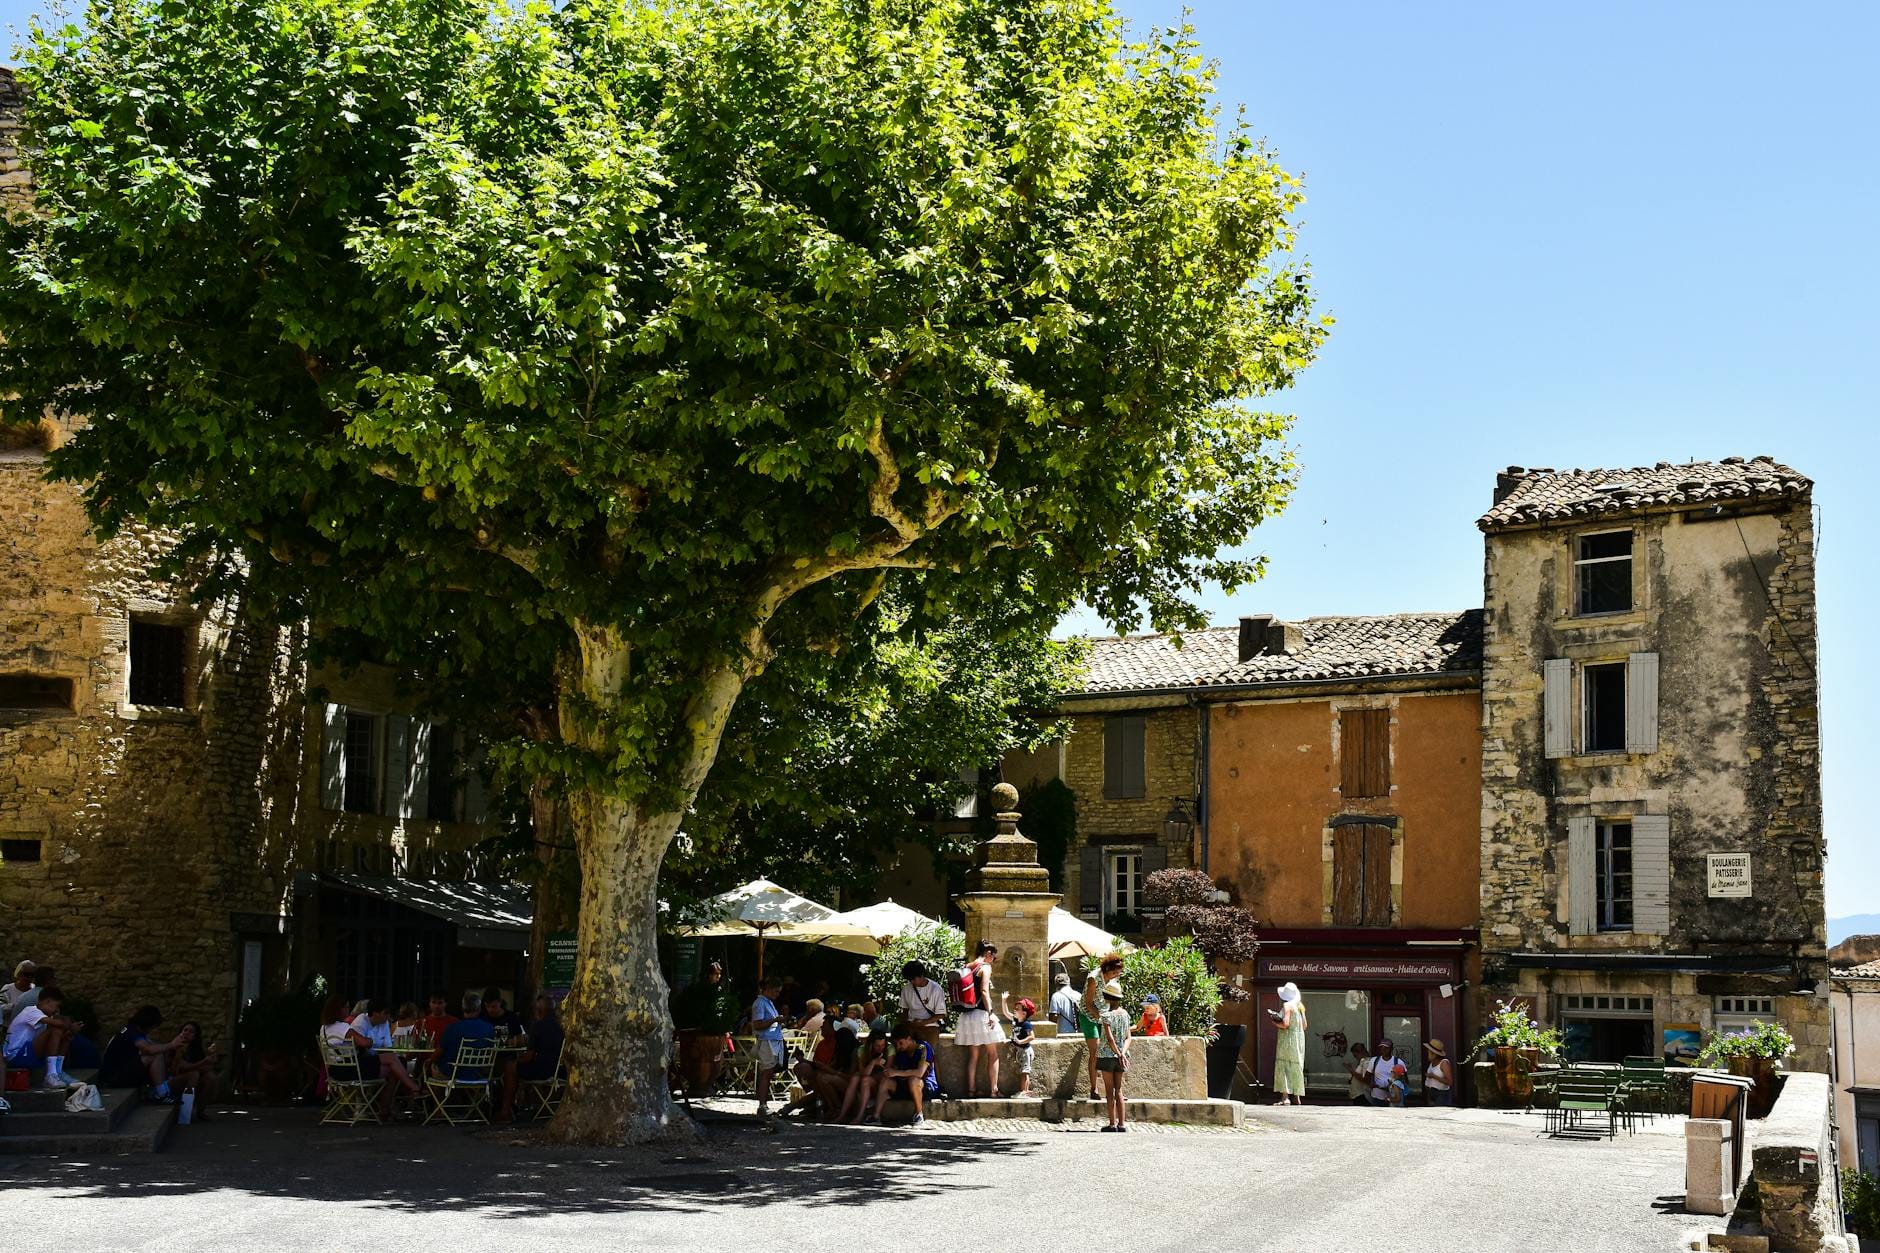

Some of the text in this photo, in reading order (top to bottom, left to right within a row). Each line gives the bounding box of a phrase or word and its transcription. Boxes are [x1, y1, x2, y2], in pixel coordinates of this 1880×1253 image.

[1712, 858, 1746, 867] BOULANGERIE
[1268, 962, 1299, 972] Lavande
[1302, 963, 1319, 972] Miel
[1322, 963, 1349, 973] Savons
[1353, 964, 1394, 973] artisanaux
[1397, 964, 1418, 974] Huile
